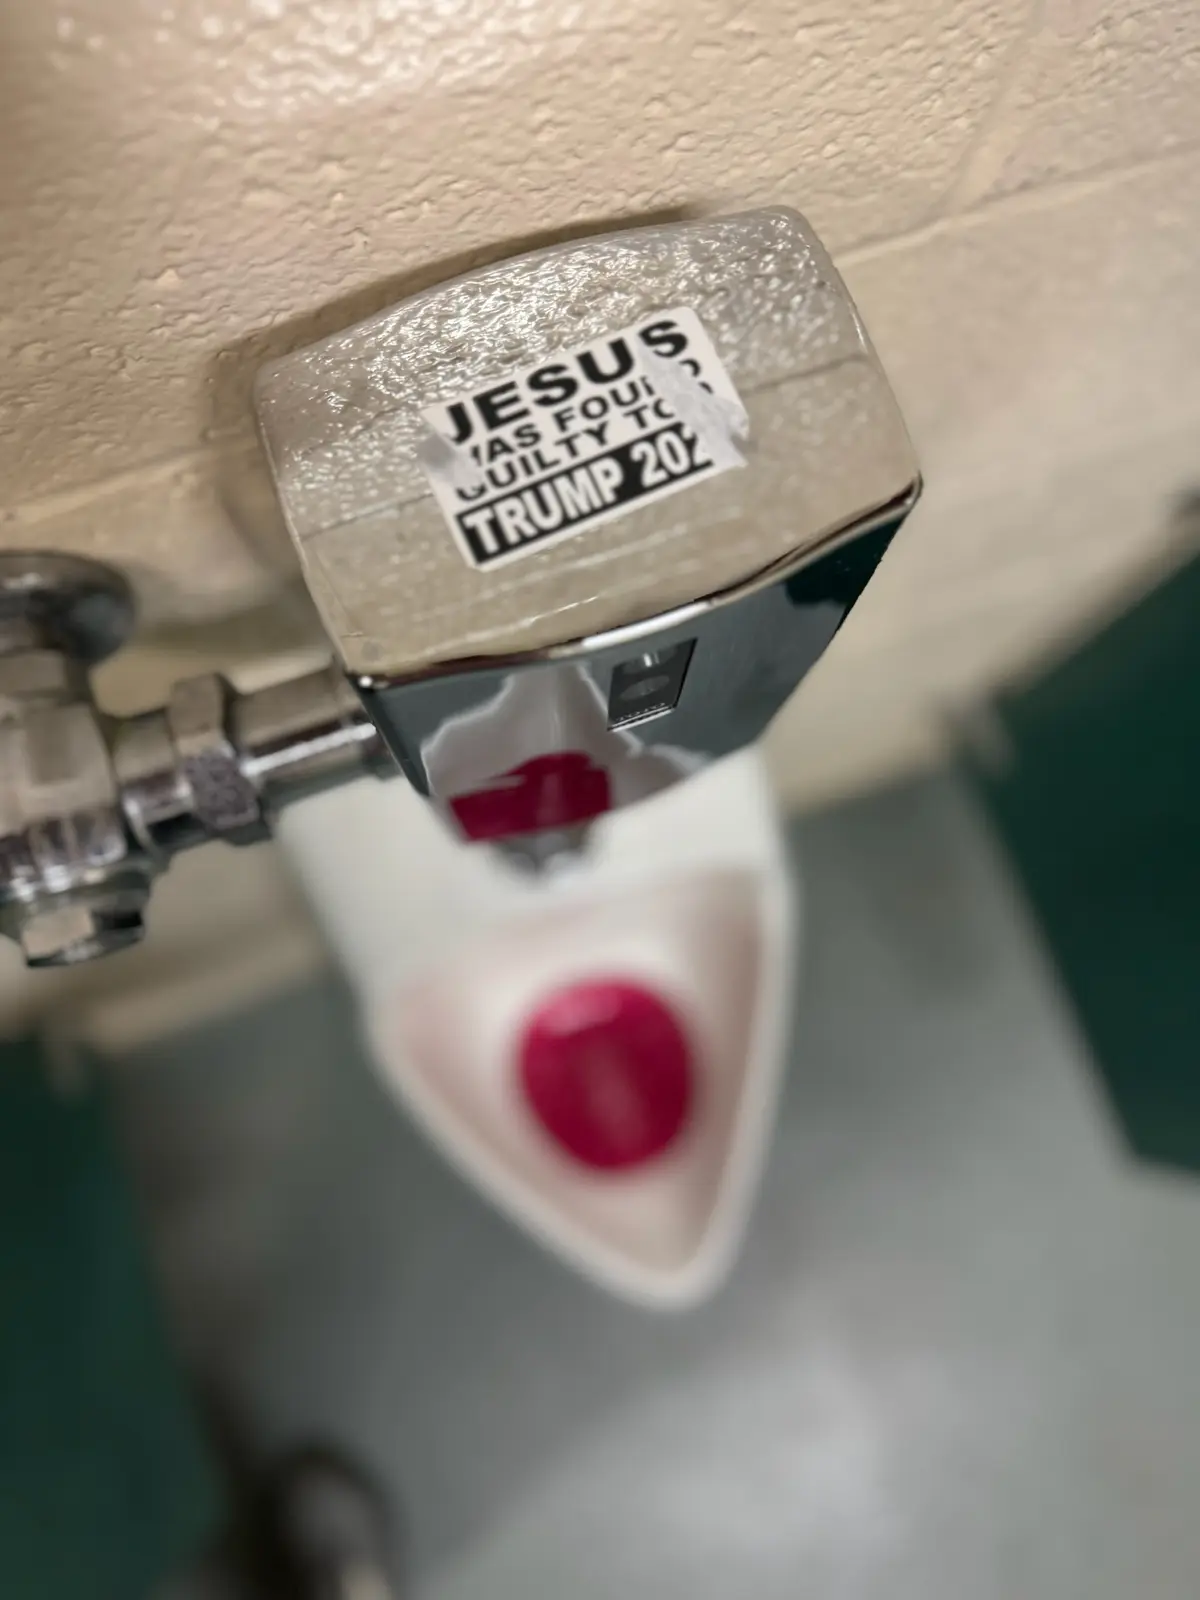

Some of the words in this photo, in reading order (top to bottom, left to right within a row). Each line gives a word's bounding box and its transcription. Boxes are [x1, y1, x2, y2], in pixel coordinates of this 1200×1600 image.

[446, 320, 688, 445] JESUS
[461, 456, 625, 555] TRUMP
[629, 424, 710, 488] 202
